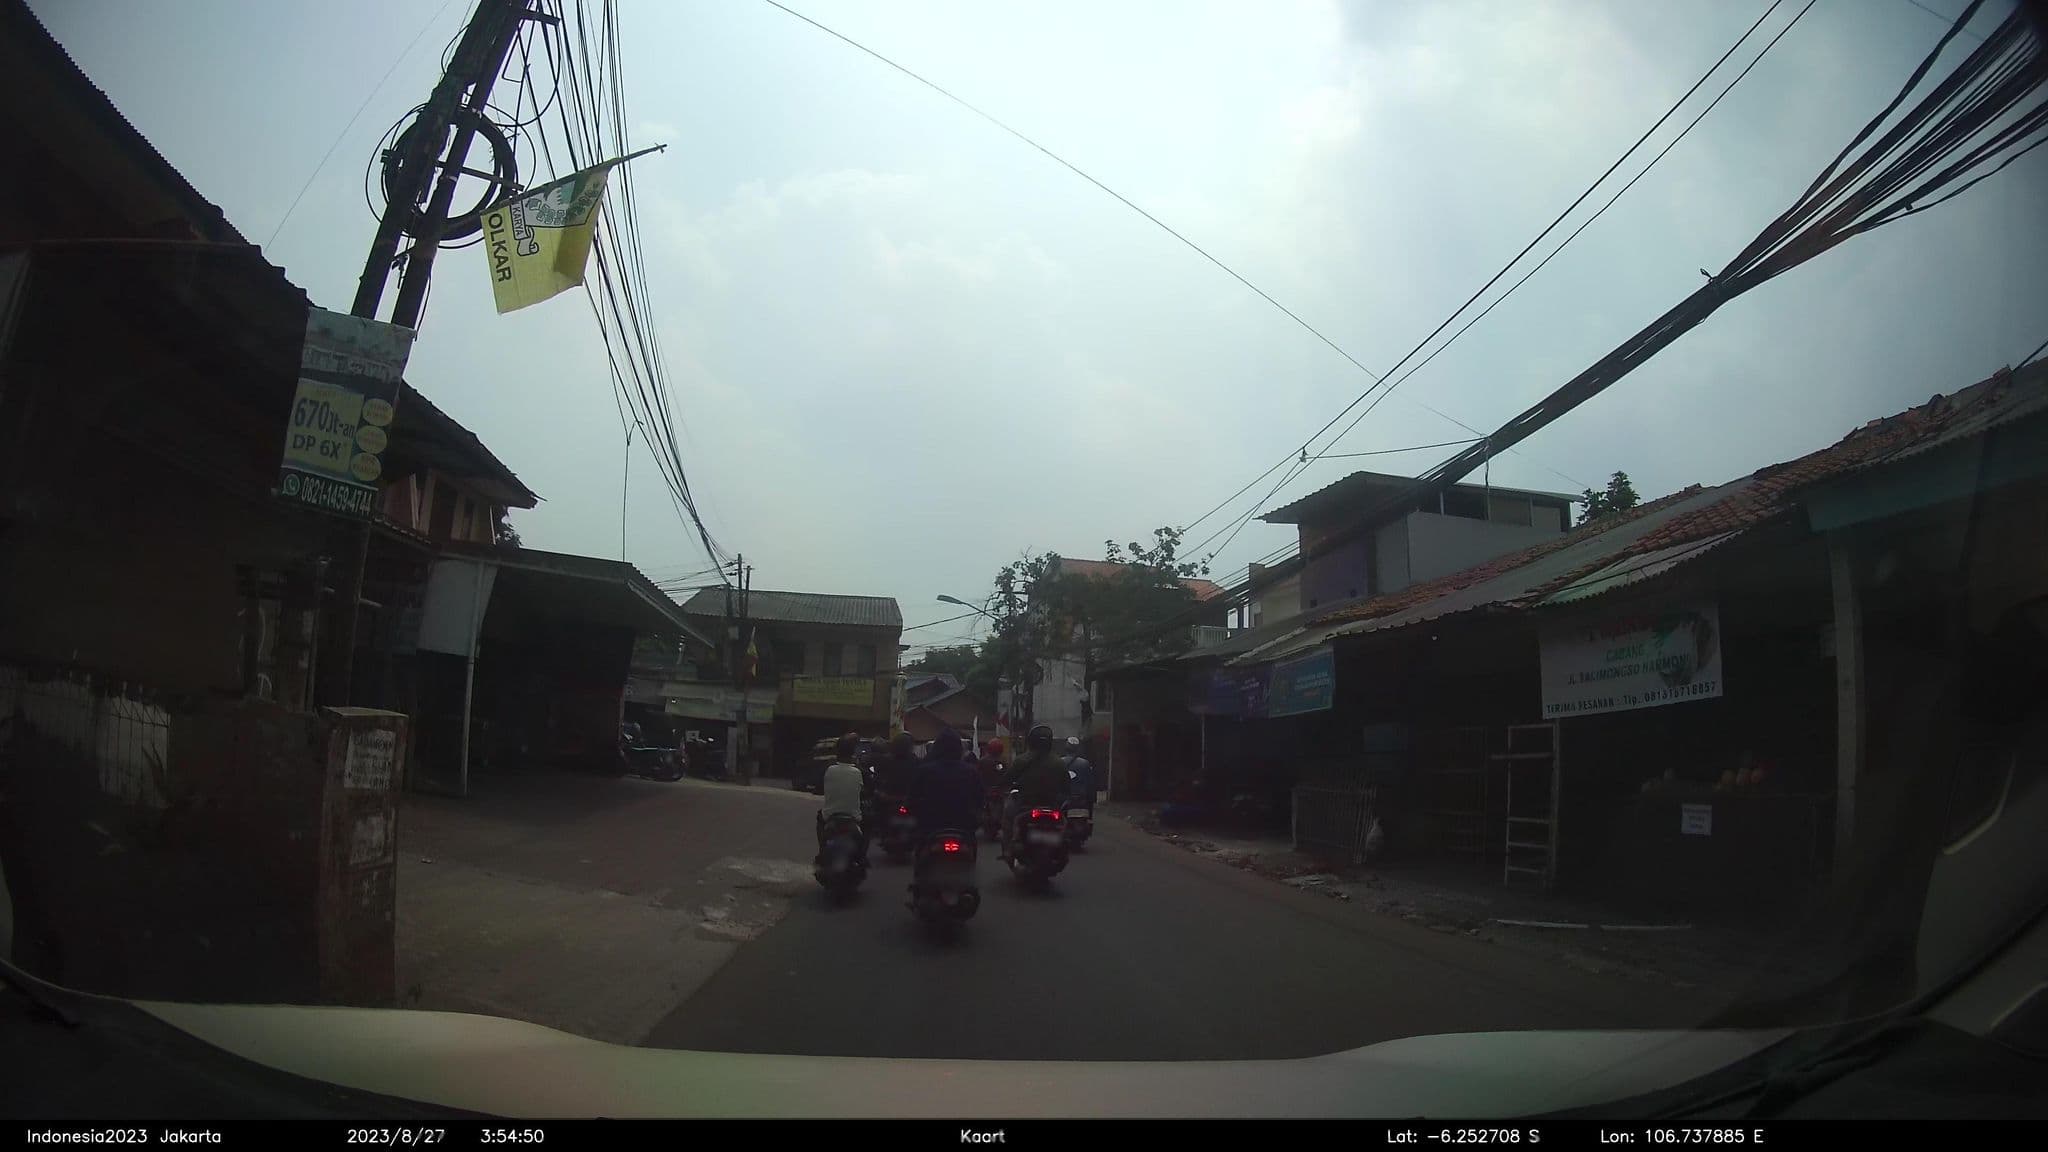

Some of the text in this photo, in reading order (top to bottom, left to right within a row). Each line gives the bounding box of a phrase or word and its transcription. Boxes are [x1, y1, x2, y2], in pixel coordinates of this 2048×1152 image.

[512, 206, 525, 236] KARYA
[488, 213, 512, 282] OLKAR
[293, 434, 342, 460] DP 6X
